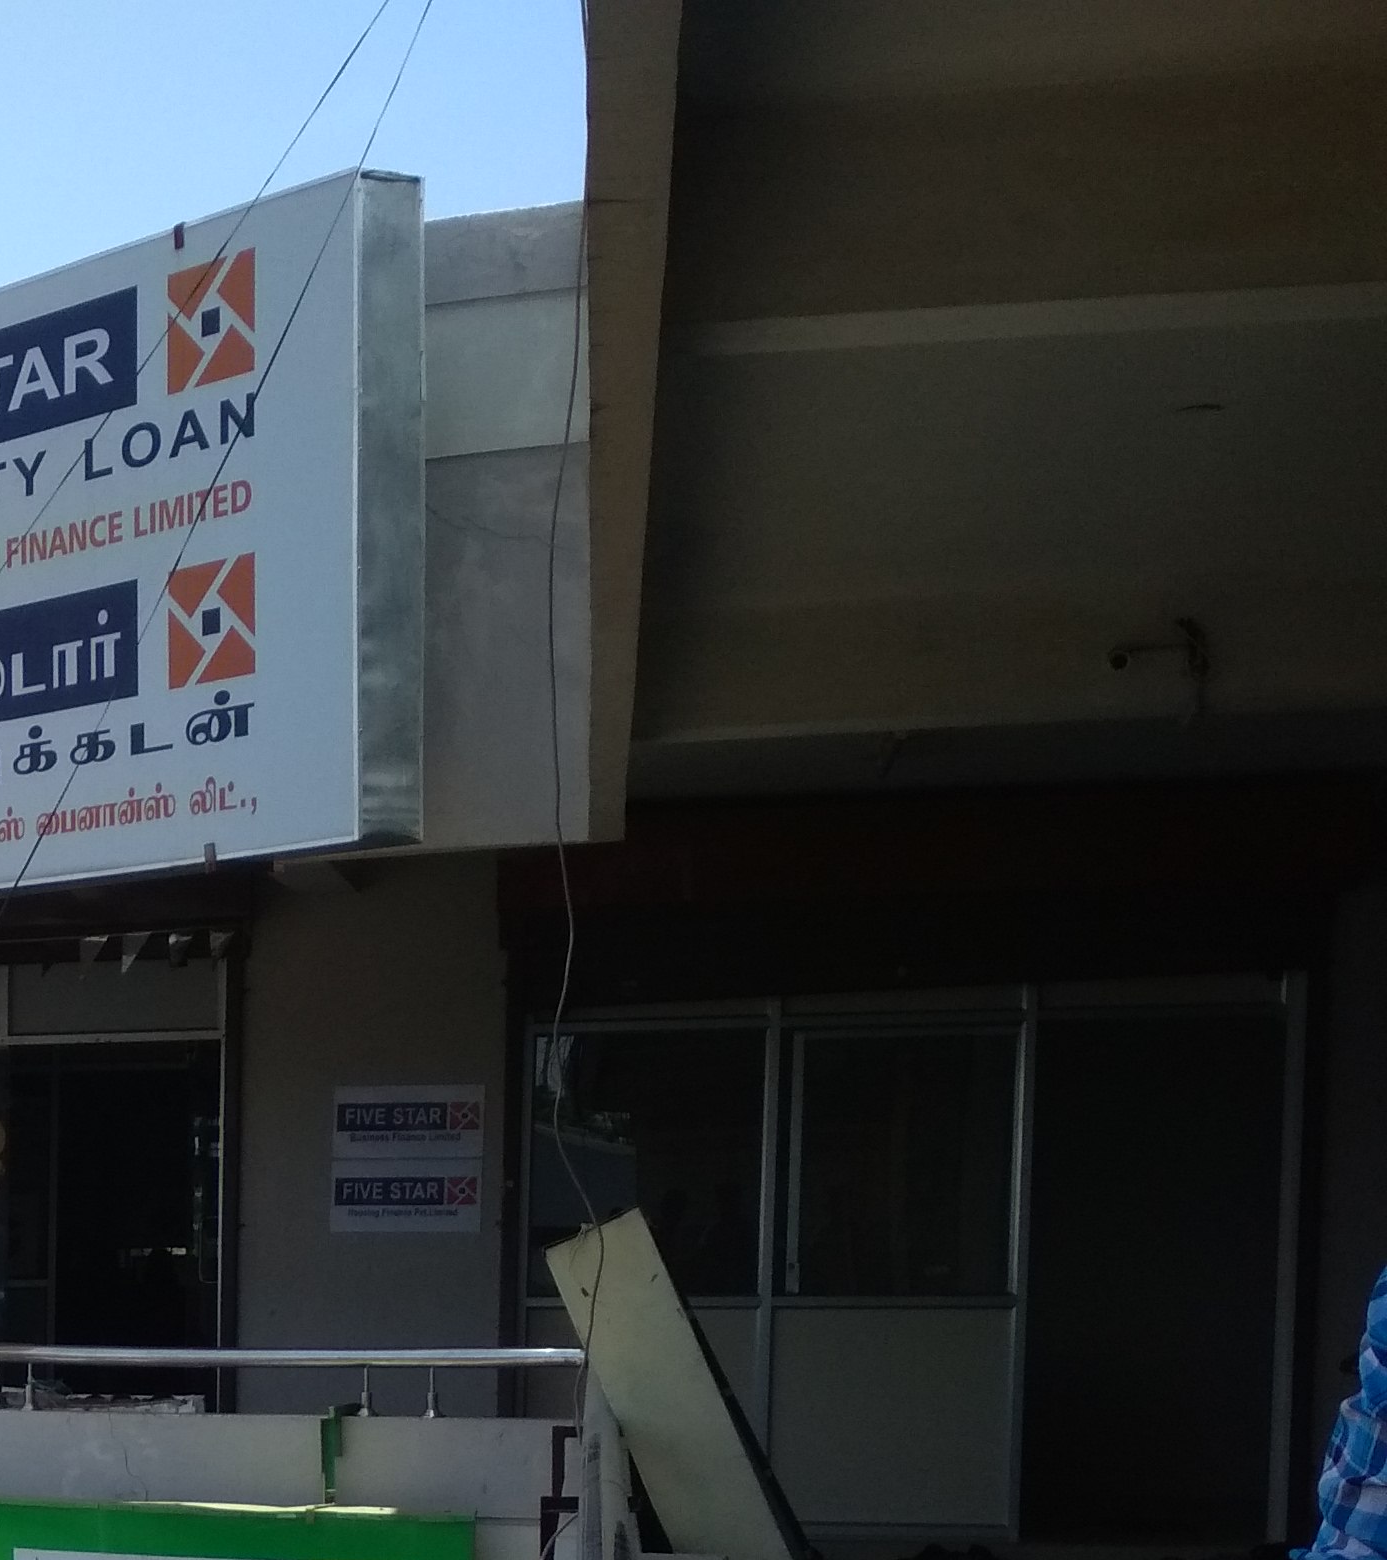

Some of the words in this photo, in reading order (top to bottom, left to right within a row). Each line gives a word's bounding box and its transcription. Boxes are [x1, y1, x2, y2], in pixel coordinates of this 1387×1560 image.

[85, 392, 256, 481] LOAN
[6, 511, 123, 568] FINANCE
[135, 479, 253, 540] LIMITED
[345, 1108, 385, 1125] FIVE
[393, 1108, 441, 1124] STAR
[342, 1183, 383, 1200] FIVE
[390, 1182, 438, 1199] STAR
